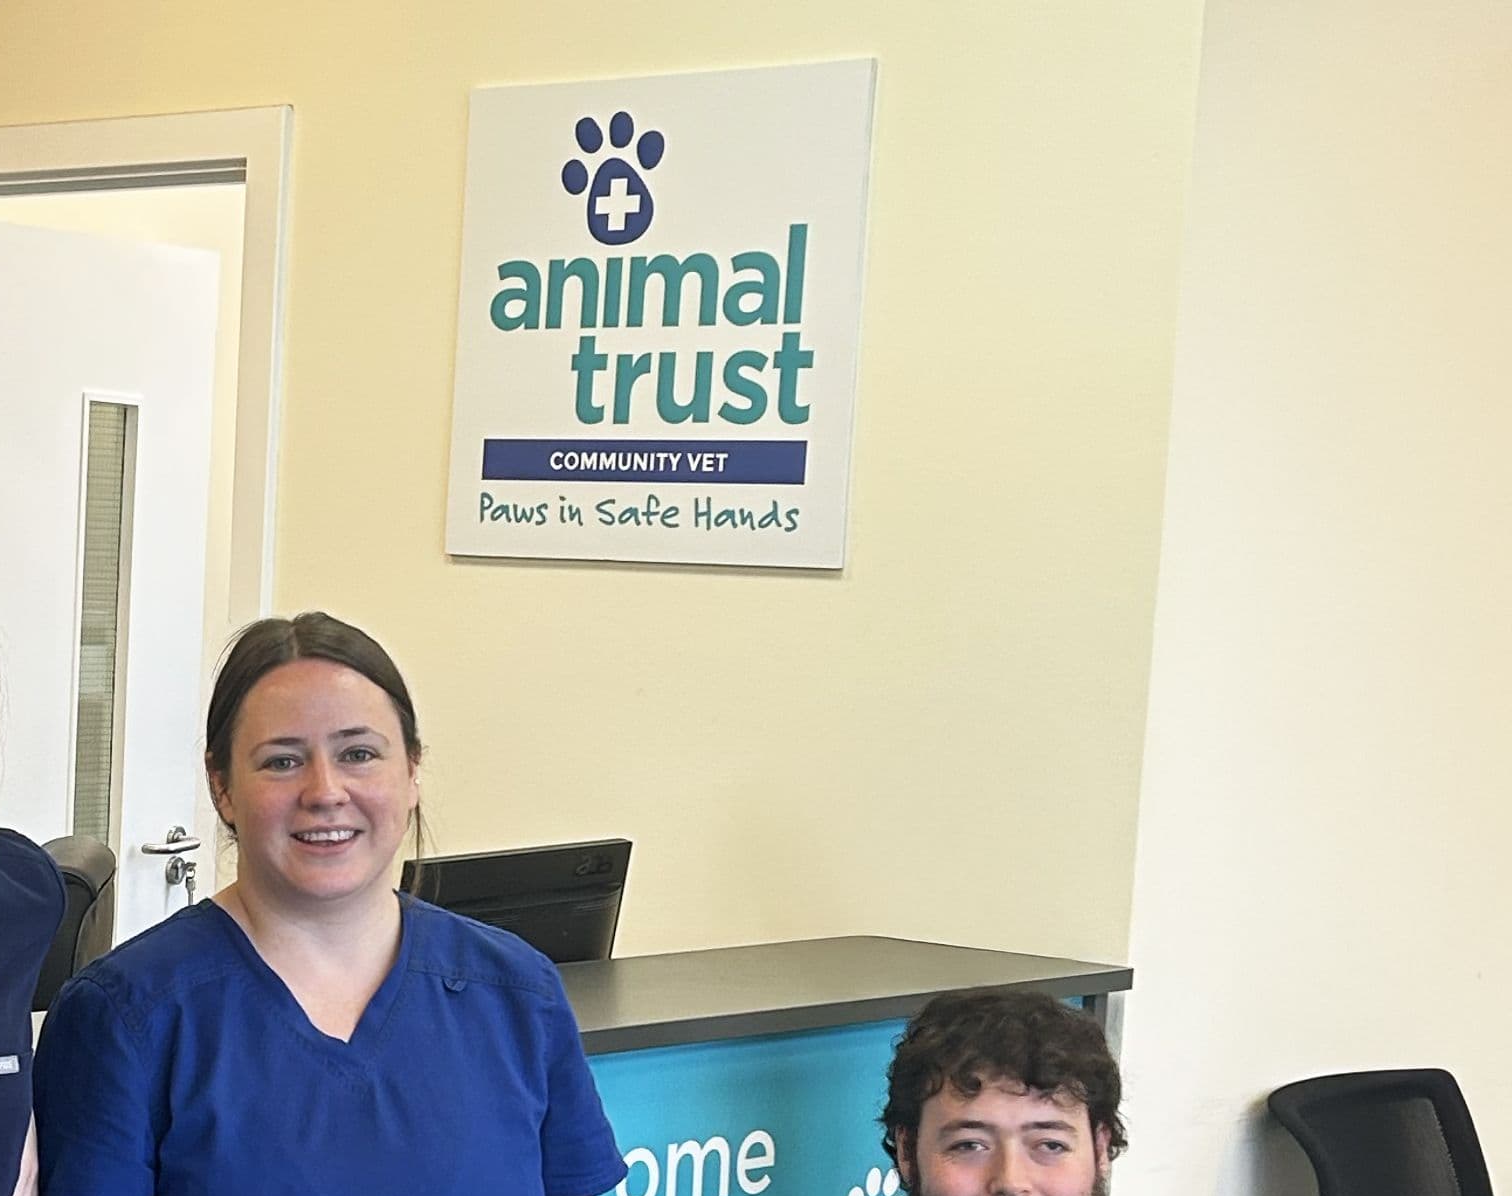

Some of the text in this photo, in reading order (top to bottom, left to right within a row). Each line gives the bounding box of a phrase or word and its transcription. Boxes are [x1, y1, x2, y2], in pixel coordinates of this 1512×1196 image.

[490, 223, 809, 332] animal
[571, 331, 814, 426] trust
[549, 450, 729, 473] COMMUNITY VET
[479, 491, 800, 532] Paws in Safe Hands
